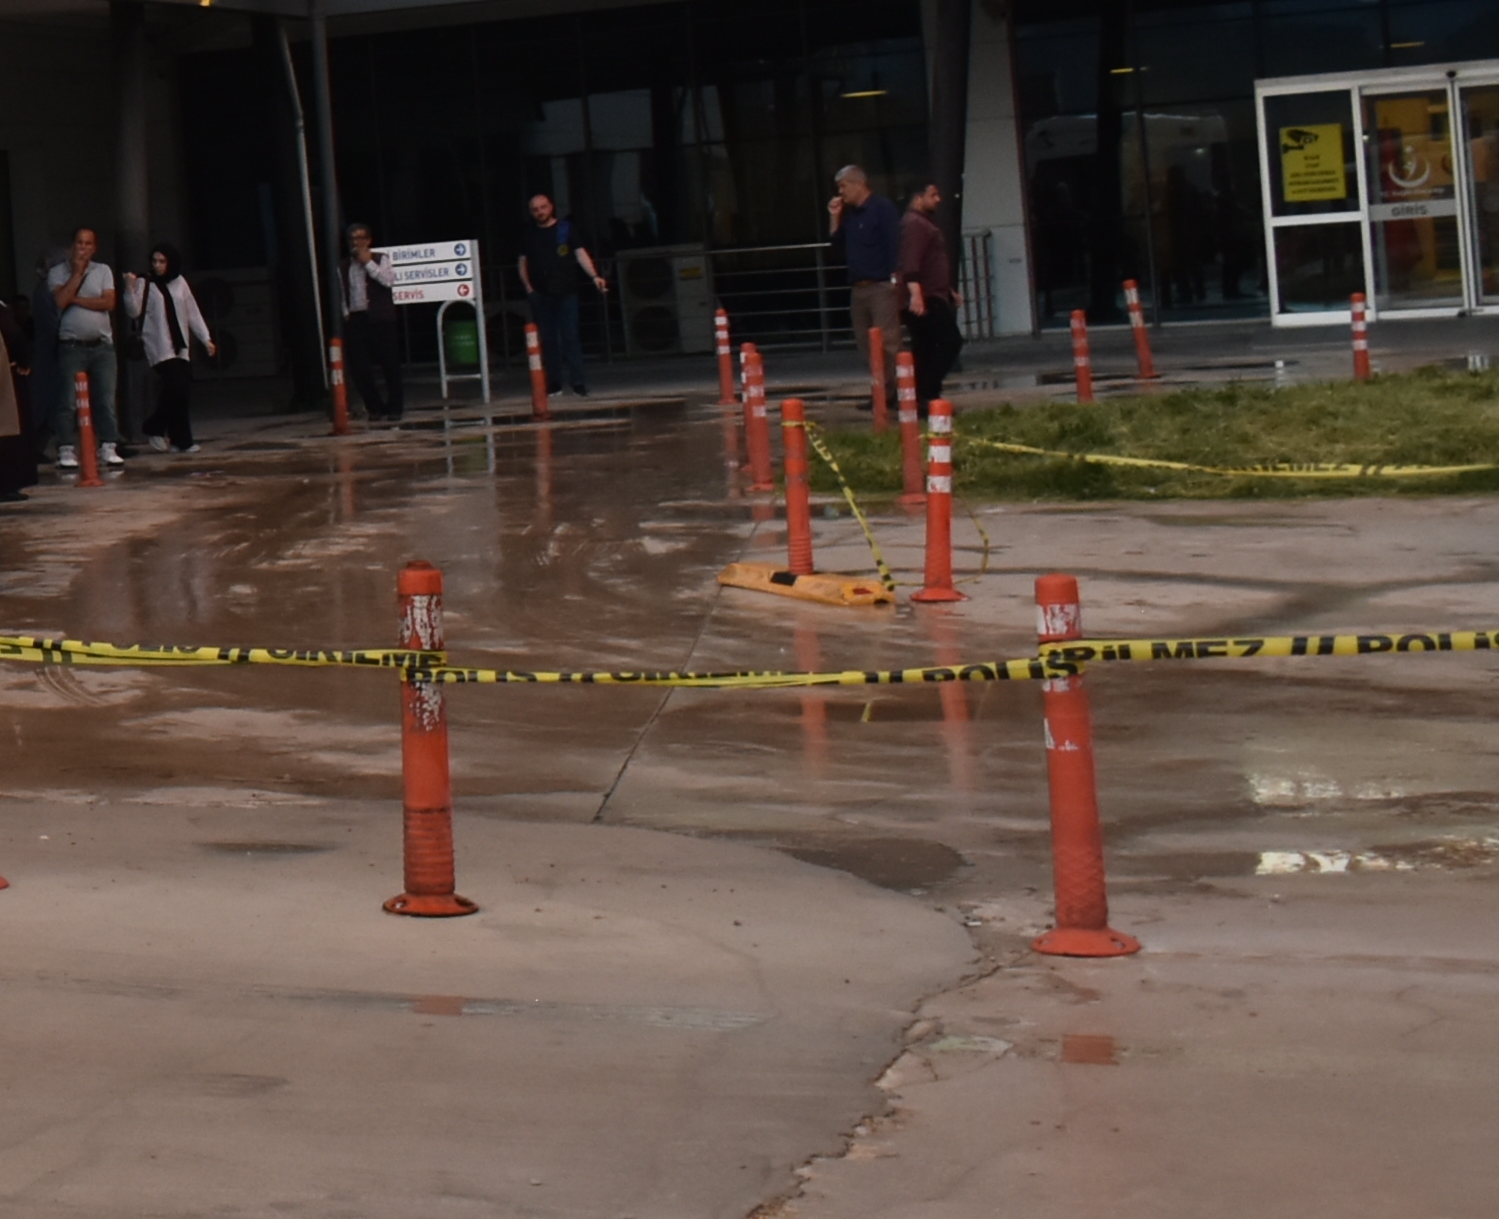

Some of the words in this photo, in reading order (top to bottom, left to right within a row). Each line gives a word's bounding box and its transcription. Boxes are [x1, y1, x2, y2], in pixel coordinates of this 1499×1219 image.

[392, 248, 436, 261] BİRİMLER
[404, 267, 450, 280] SERVİSLER
[392, 289, 425, 300] SERVİS
[1357, 632, 1499, 654] POLİ
